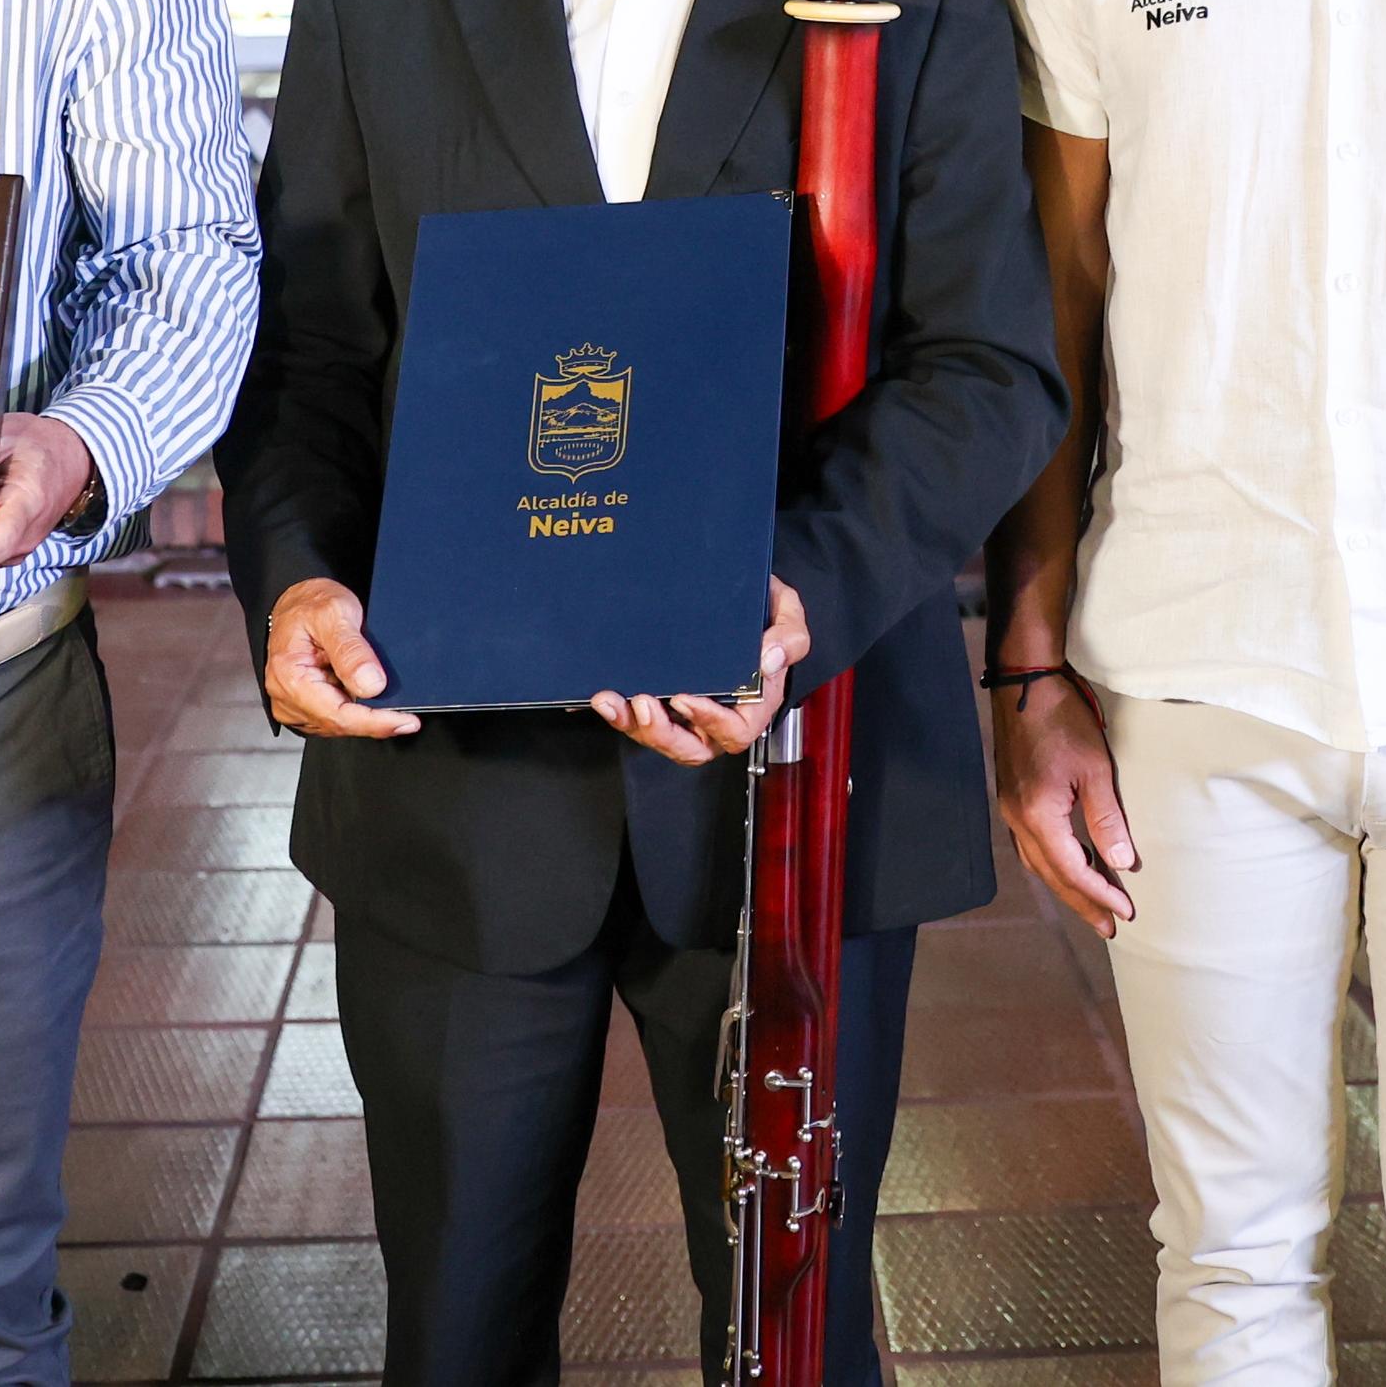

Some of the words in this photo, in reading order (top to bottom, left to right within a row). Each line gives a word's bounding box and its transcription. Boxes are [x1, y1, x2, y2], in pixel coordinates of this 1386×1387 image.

[1146, 3, 1208, 30] Neiva
[516, 490, 598, 513] Alcaldía
[603, 490, 629, 508] de
[528, 511, 615, 539] Neiva
